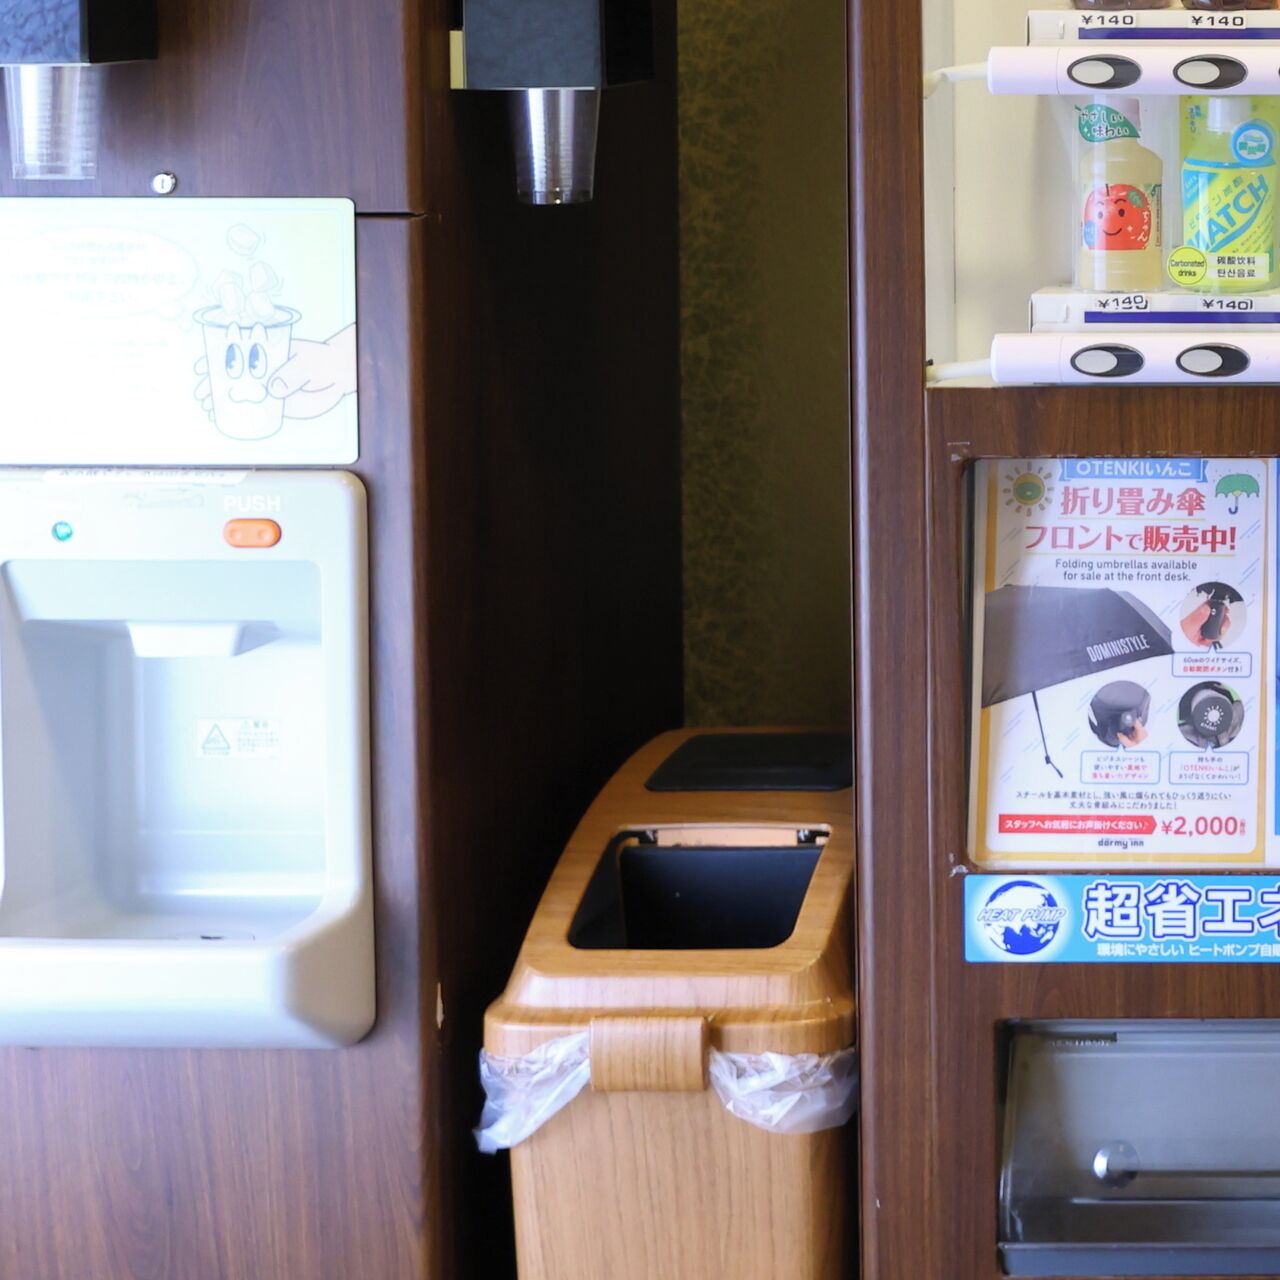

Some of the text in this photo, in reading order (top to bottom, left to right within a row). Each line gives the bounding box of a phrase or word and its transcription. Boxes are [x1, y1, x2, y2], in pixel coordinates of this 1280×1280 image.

[1170, 260, 1205, 268] Carbonated
[223, 495, 281, 512] PUSH
[1060, 486, 1206, 516] 折り畳み傘
[1025, 525, 1237, 553] フロントで販売中!
[1055, 559, 1197, 571] Folding umbrellas available
[1063, 570, 1191, 581] for sale at the front desk.
[1086, 634, 1149, 663] DOMINISTYLE
[1161, 816, 1239, 838] ¥2,000
[977, 907, 1066, 920] HEAT PUMP
[1097, 944, 1184, 957] 環境にやさしい
